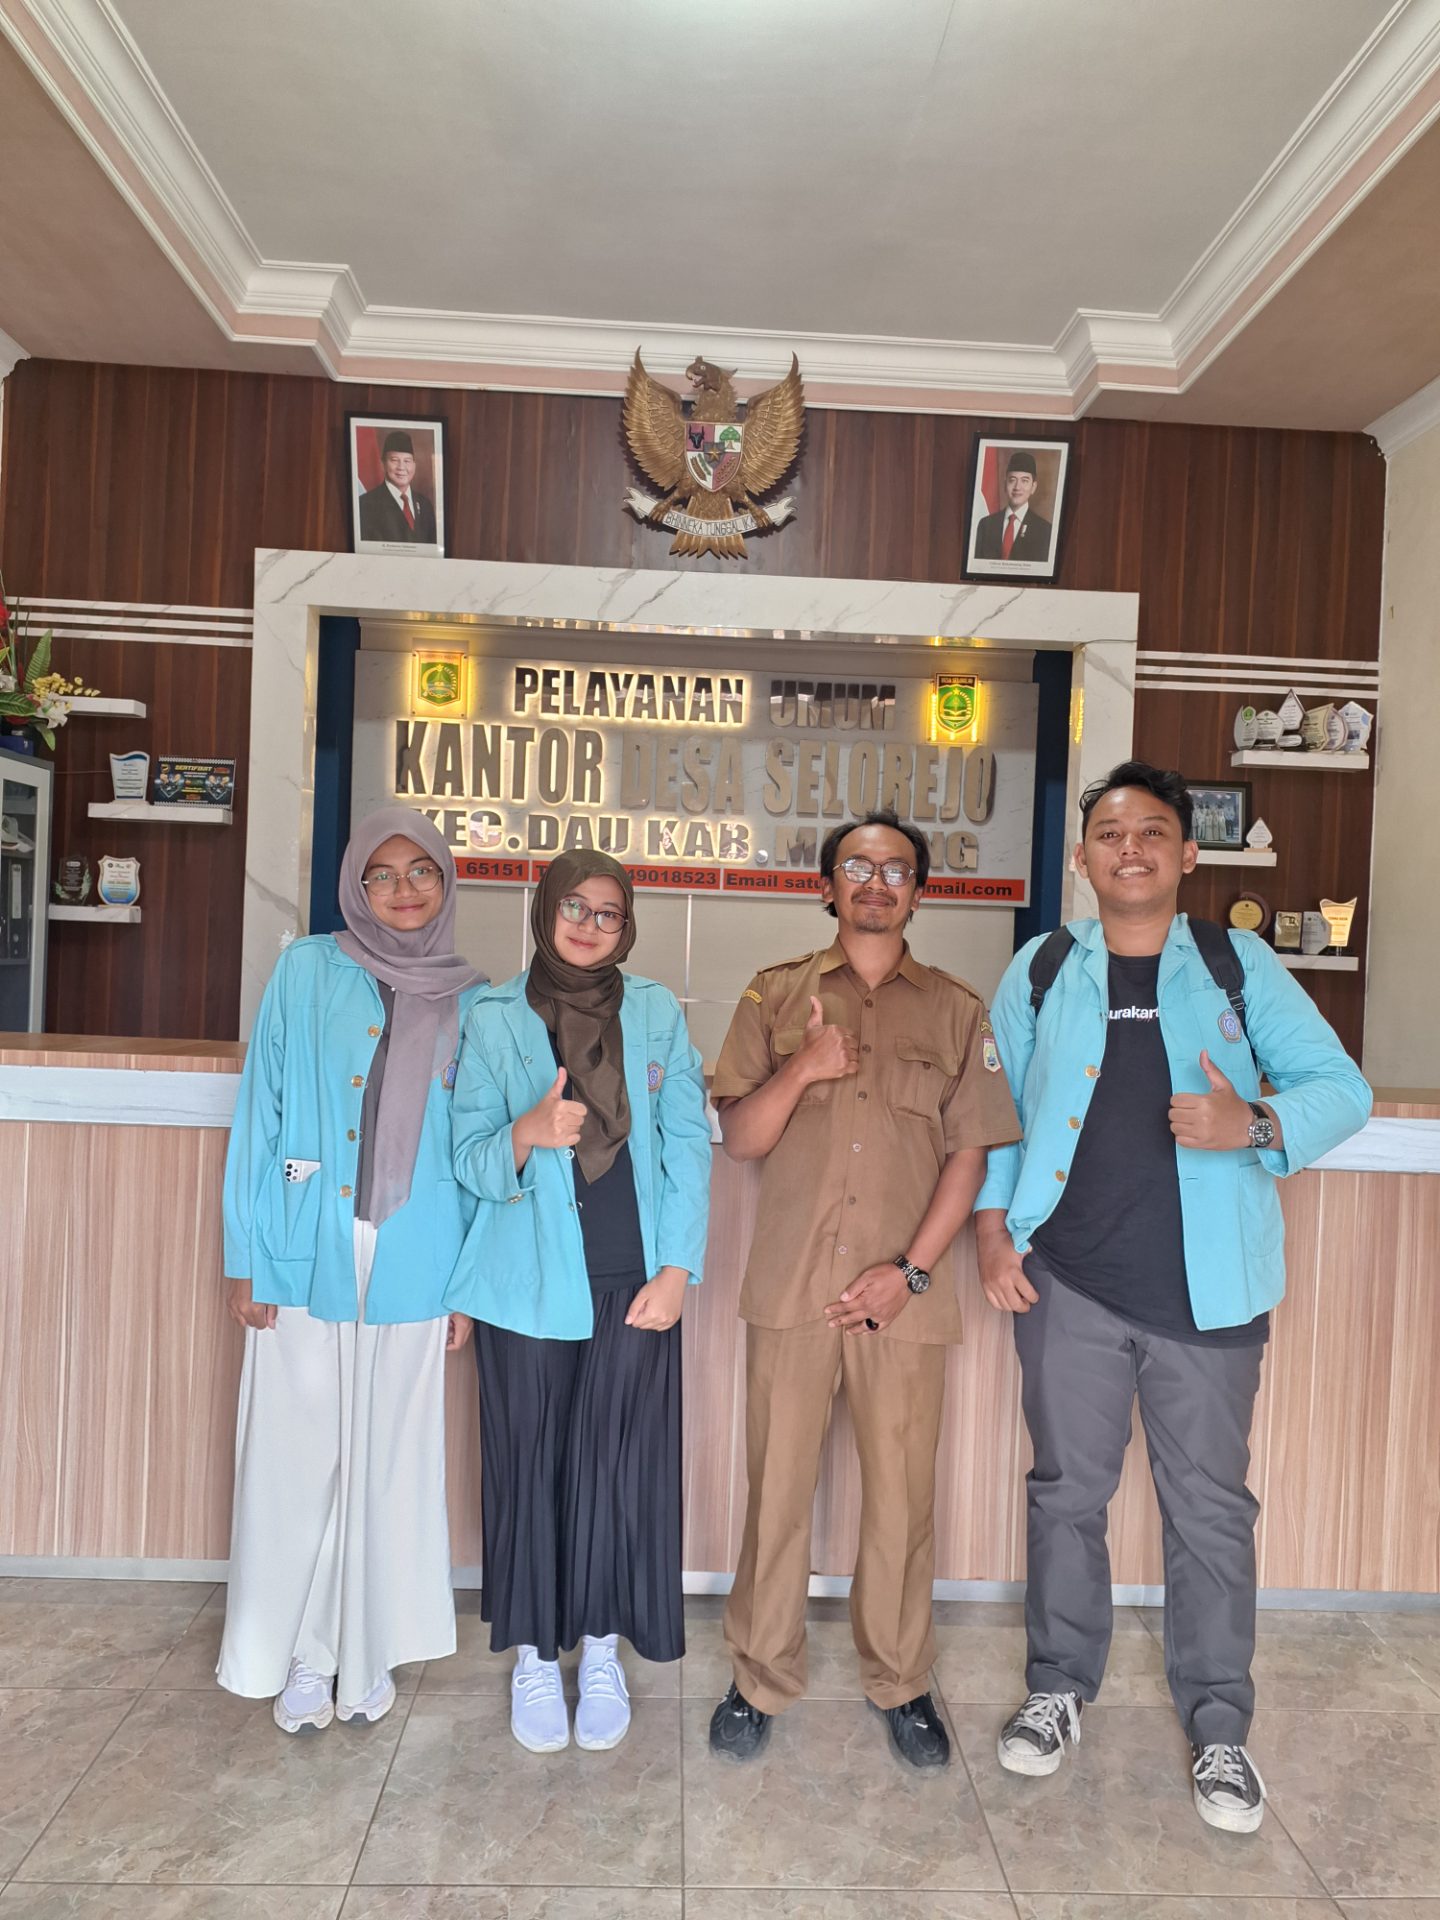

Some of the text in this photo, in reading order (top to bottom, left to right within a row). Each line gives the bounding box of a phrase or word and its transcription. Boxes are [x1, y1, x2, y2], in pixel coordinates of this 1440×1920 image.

[665, 511, 703, 535] BHINNEKA
[704, 518, 743, 536] TUNGGAL
[514, 667, 896, 731] PELAYANAN UMUM
[395, 720, 997, 823] KANTOR DESA SELOREJO
[466, 862, 524, 877] 65151
[624, 868, 716, 885] 49018523
[726, 873, 778, 888] Email
